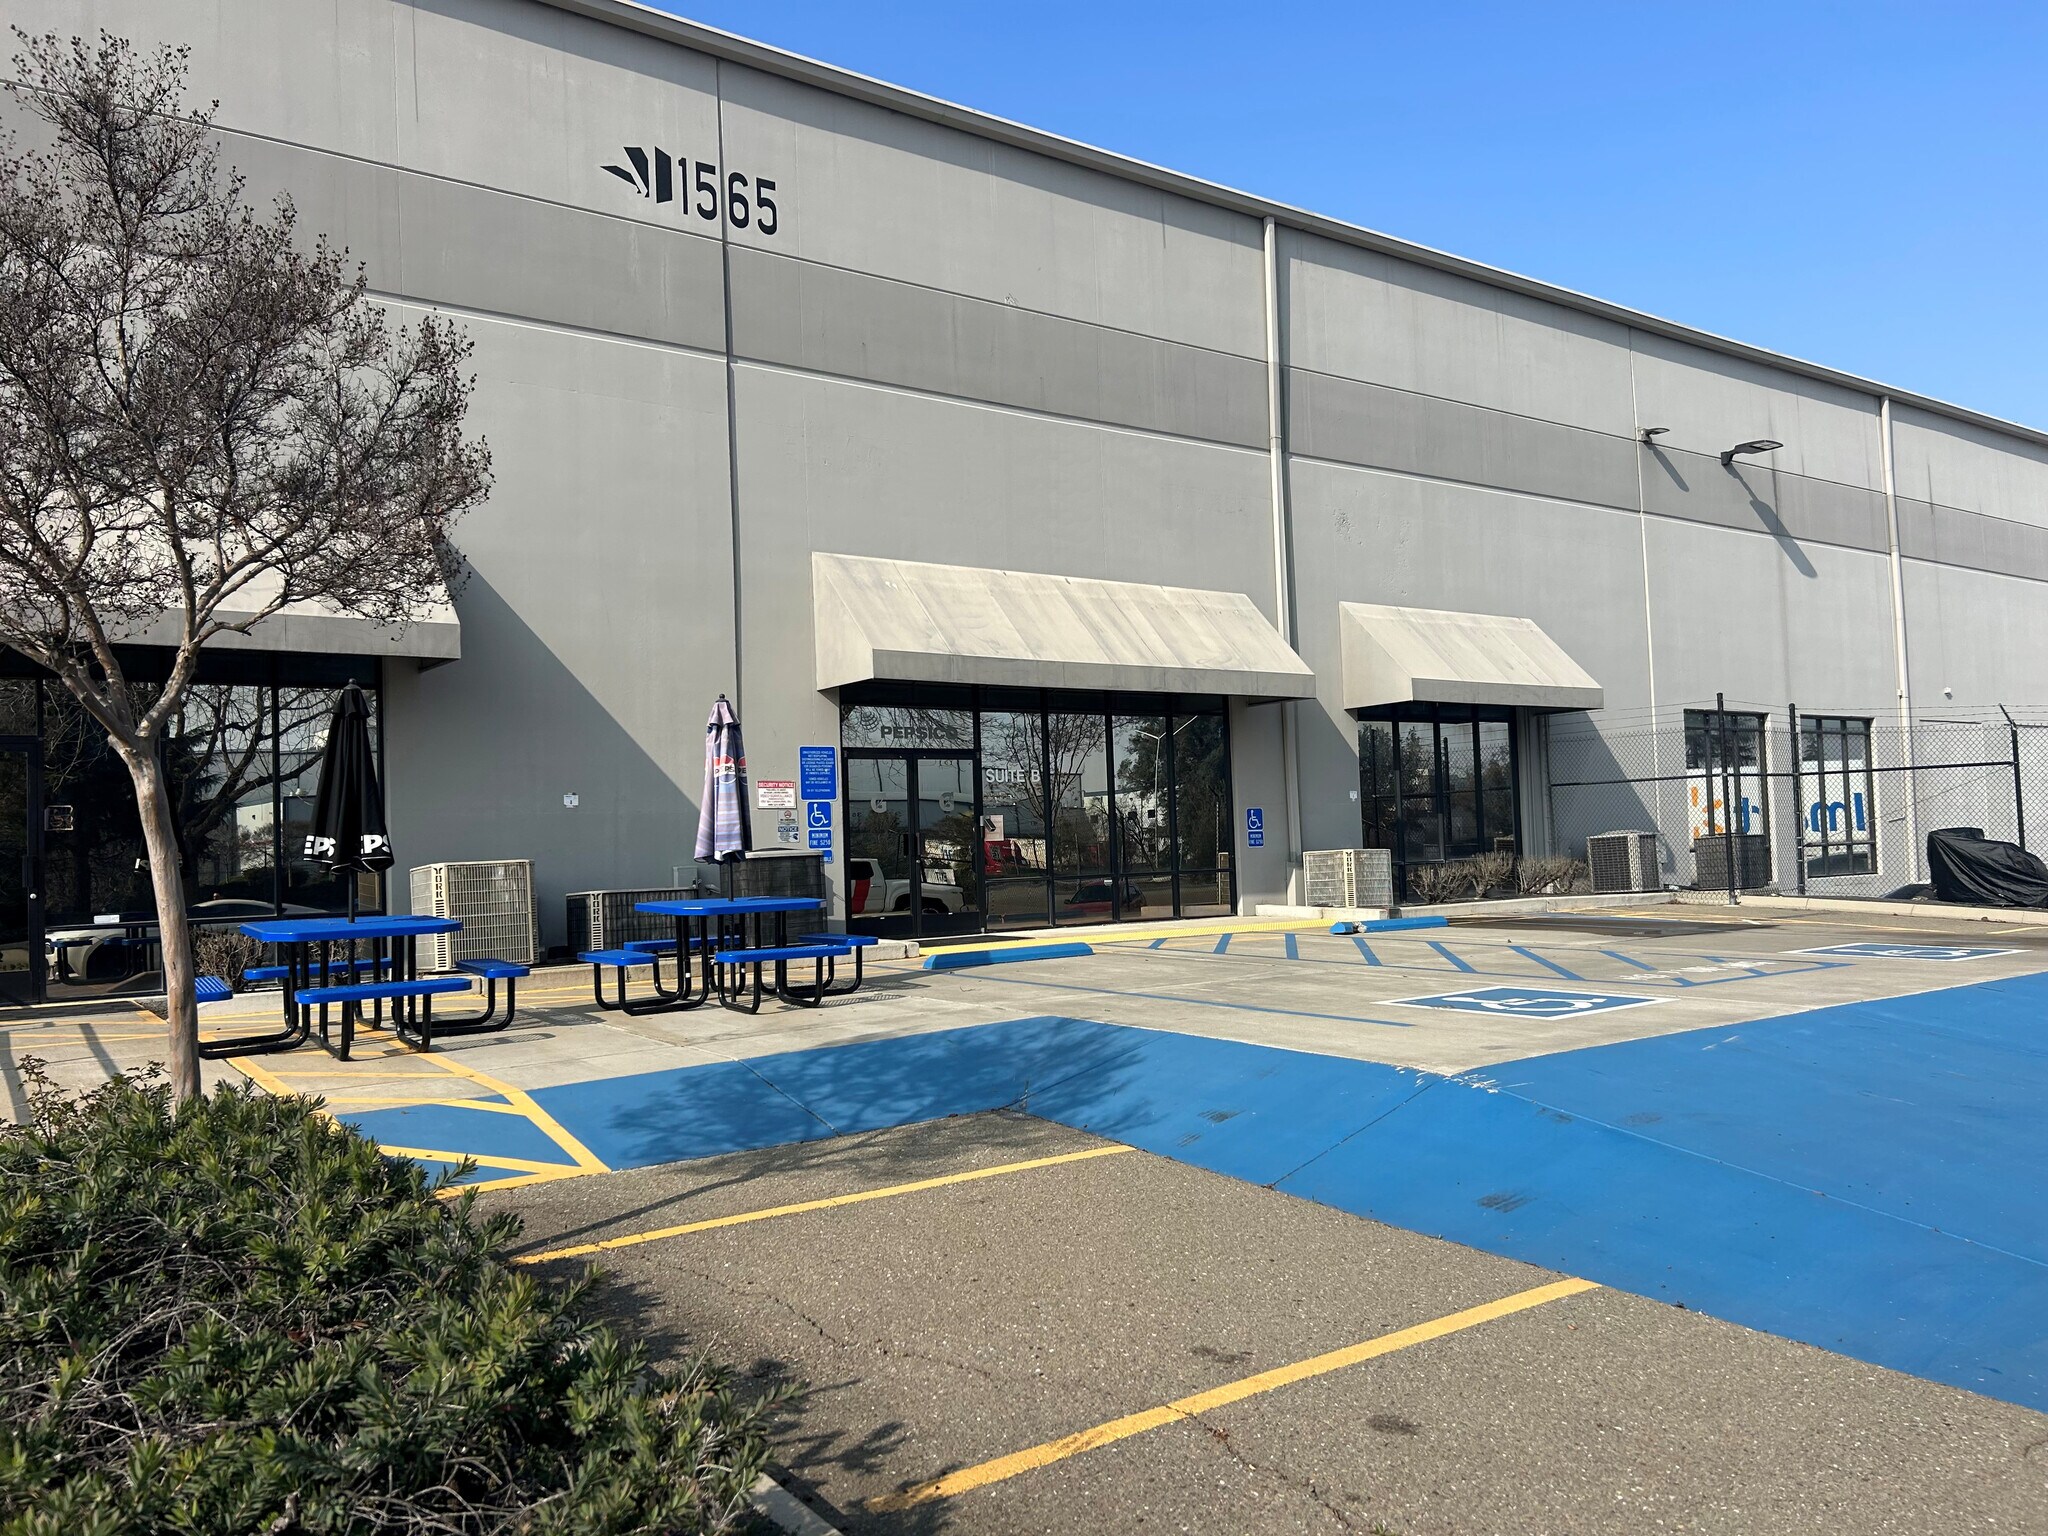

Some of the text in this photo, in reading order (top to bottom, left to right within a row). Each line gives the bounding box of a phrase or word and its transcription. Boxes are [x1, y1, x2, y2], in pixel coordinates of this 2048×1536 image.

[678, 157, 777, 235] 1565
[880, 726, 958, 740] PEPSICO
[985, 769, 1041, 783] SUITE B
[433, 867, 443, 898] YORK
[591, 893, 602, 922] YORK
